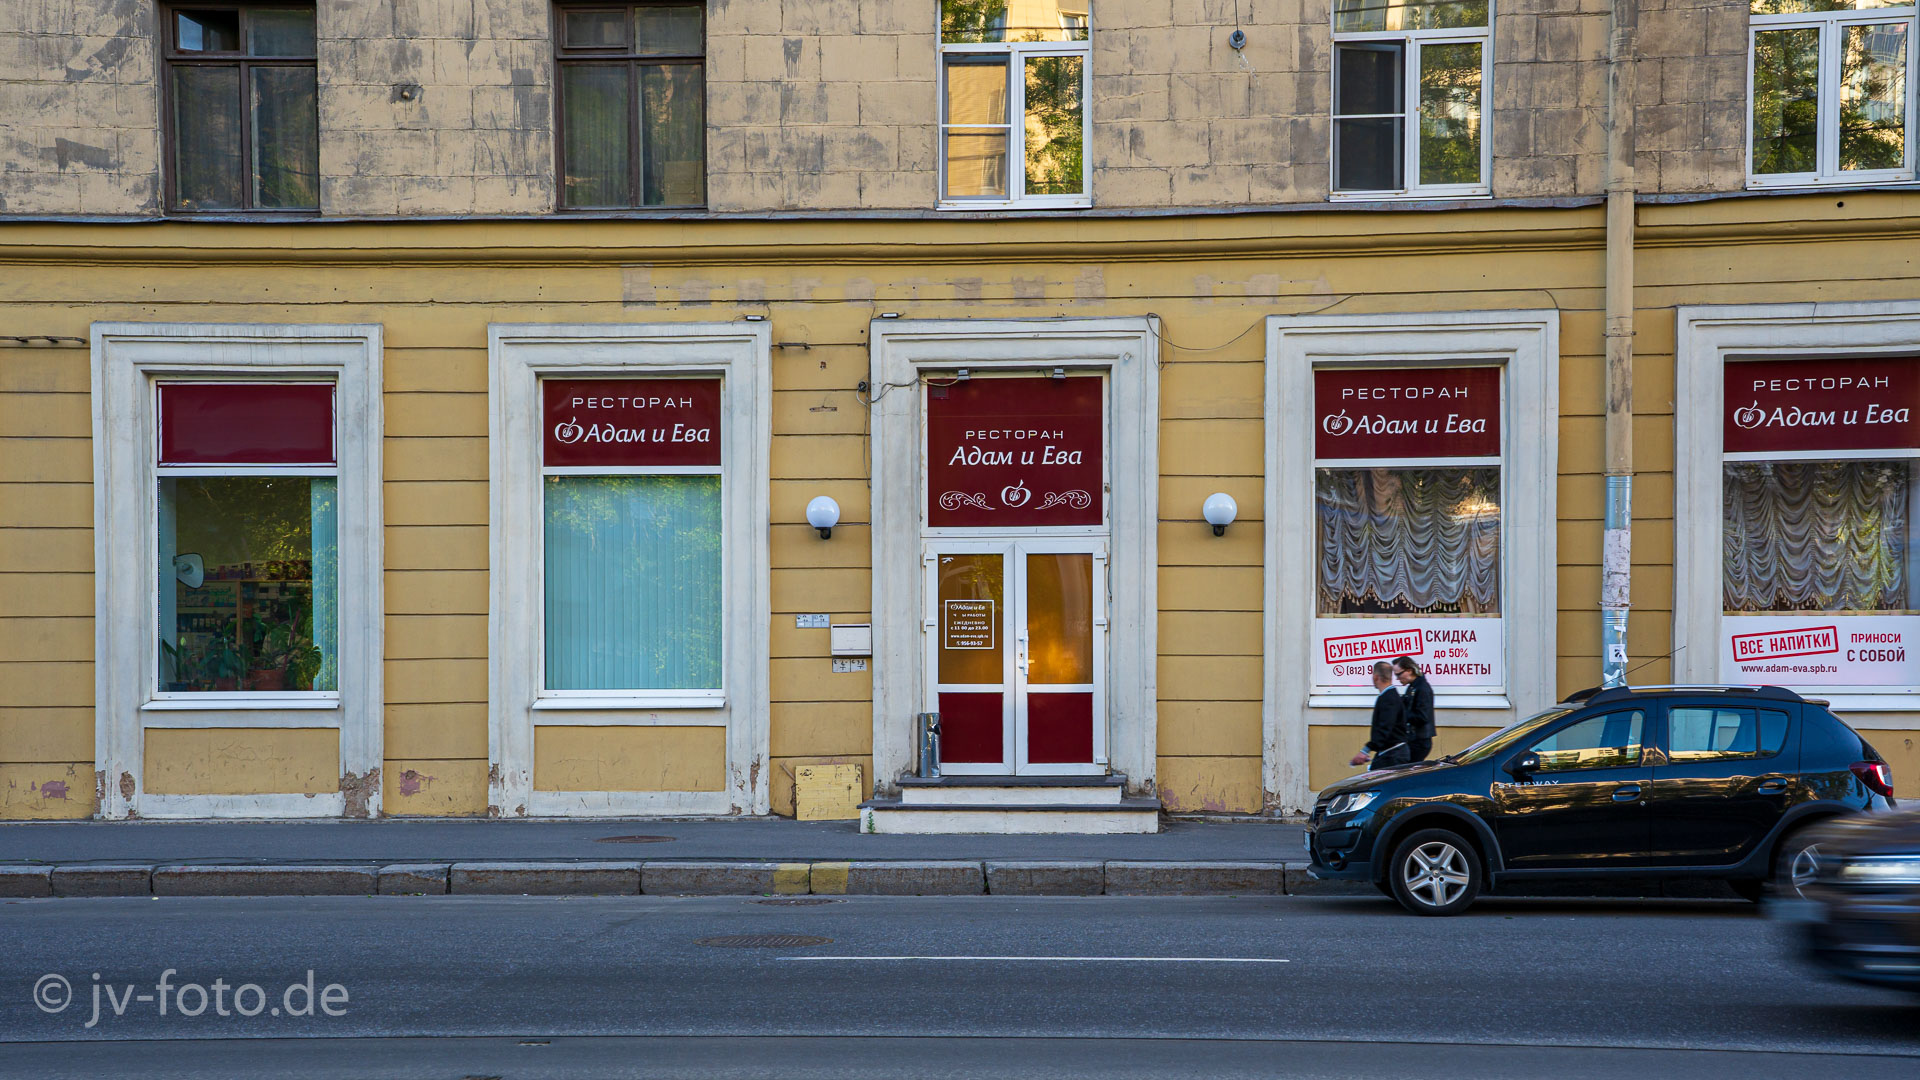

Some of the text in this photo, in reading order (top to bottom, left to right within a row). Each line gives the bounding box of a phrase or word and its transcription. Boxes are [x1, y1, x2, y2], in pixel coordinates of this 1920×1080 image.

[1754, 376, 1889, 392] РЕСТОРАН
[1342, 387, 1468, 399] РЕСТОРАН
[572, 397, 692, 408] РЕСТОРАН
[1765, 404, 1910, 427] Адам и Ева
[1352, 414, 1486, 434] Адам и Ева
[583, 424, 710, 442] Адам и Ева
[966, 430, 1063, 439] РЕСТОРАН
[948, 446, 1082, 465] Адам и Ева
[1425, 630, 1476, 644] СКИДКА
[1740, 633, 1831, 655] ВСЕ НАПИТКИ
[1851, 633, 1901, 643] ПРИНОСИ
[1329, 642, 1367, 658] СУПЕР
[1434, 648, 1468, 659] до 50%
[1847, 646, 1905, 662] С СОБОЙ
[1436, 664, 1491, 675] БАНКЕТЫ
[1741, 664, 1837, 674] www.adam-eva.spb.ru
[1498, 780, 1558, 789] STEPWAY
